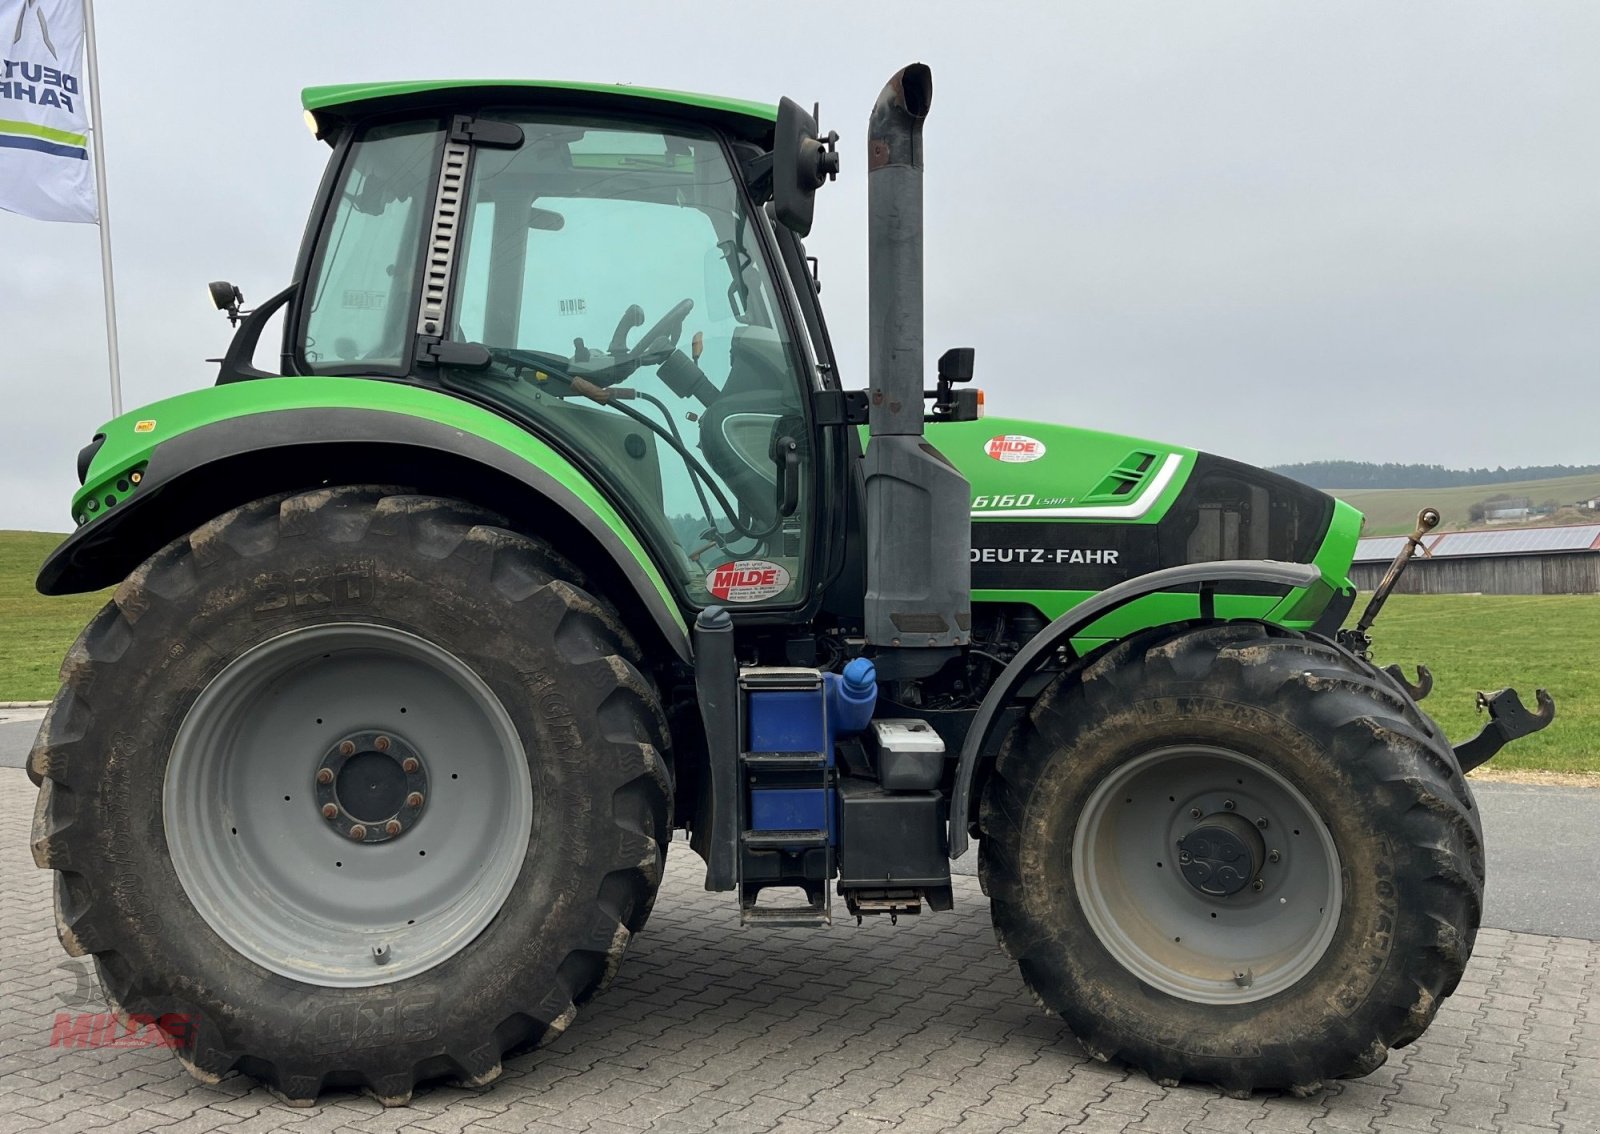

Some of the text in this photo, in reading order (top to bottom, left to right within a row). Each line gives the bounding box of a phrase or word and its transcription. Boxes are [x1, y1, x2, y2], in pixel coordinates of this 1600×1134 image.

[990, 441, 1035, 453] MILDE
[972, 494, 1035, 508] 6160
[971, 548, 1119, 564] DEUTZ-FAHR
[713, 570, 776, 588] MILDE
